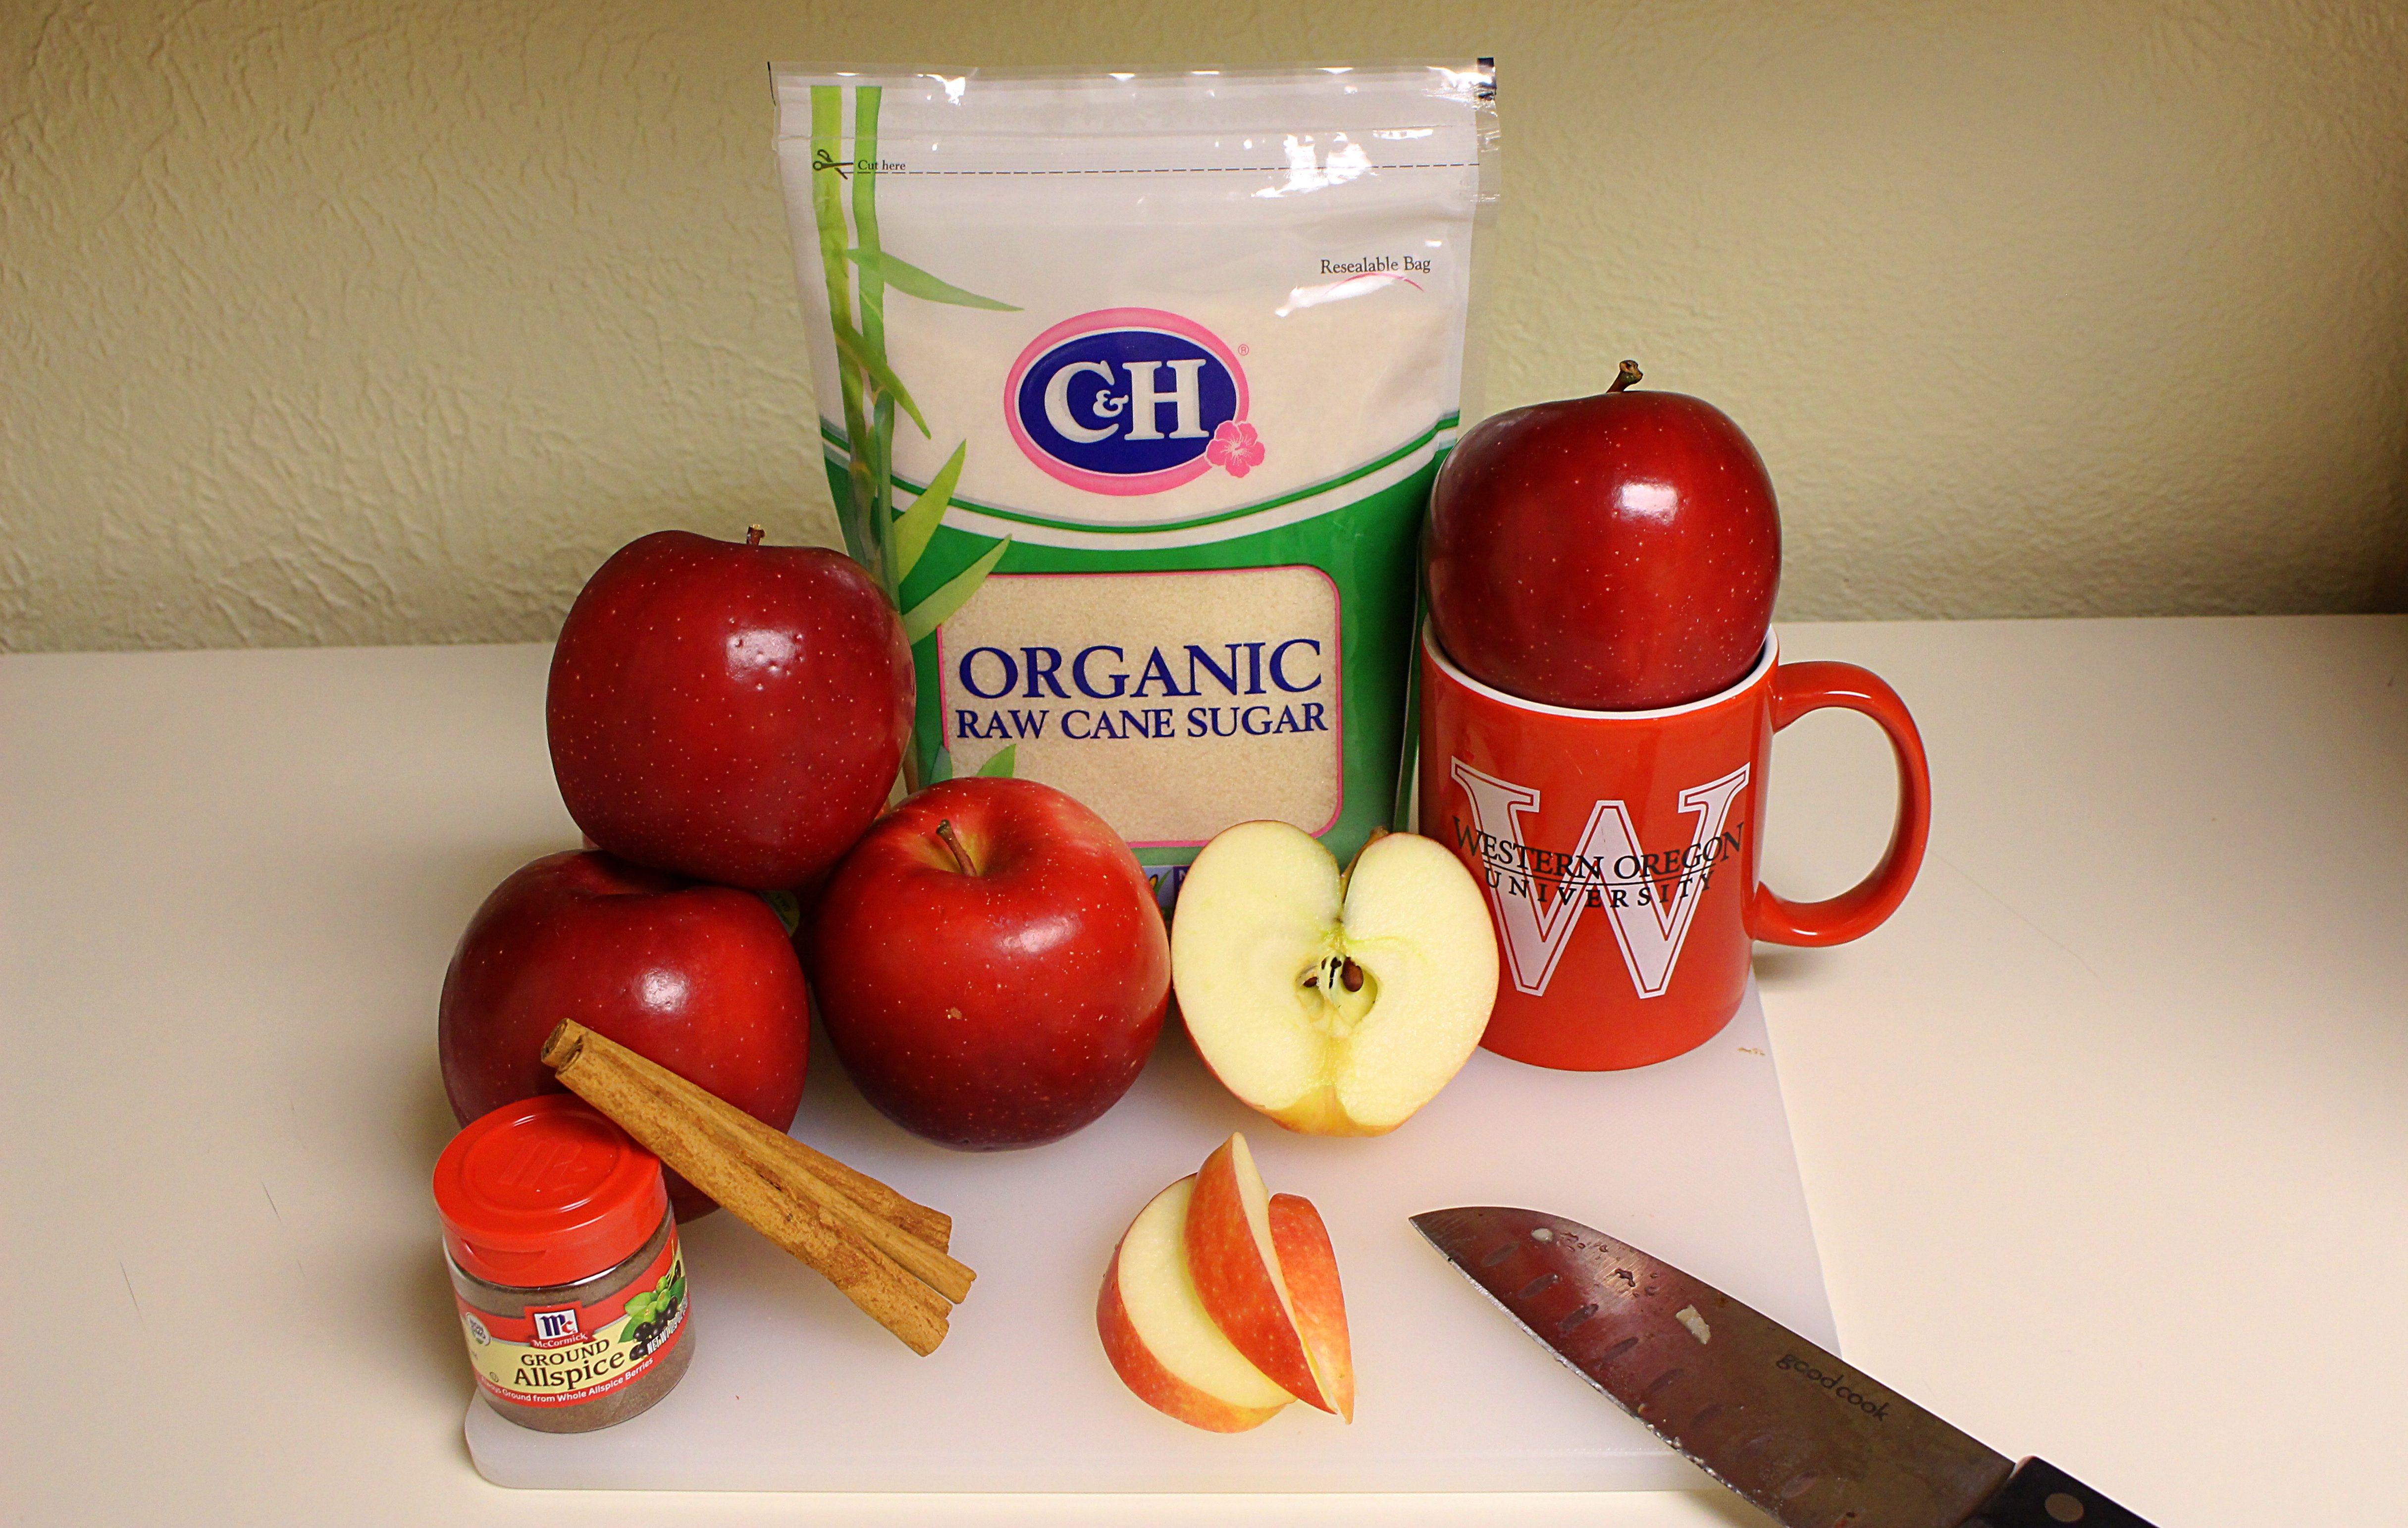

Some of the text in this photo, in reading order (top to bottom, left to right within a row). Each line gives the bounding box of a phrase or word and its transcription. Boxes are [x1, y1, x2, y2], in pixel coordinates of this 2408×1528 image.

[858, 159, 906, 170] Cut here
[1320, 255, 1431, 274] Resealable Bag
[1044, 358, 1209, 444] C&H
[958, 638, 1323, 699] ORGANIC
[955, 702, 1329, 739] RAW CANE SUGAR
[1452, 815, 1744, 880] WESTERN OREGON
[1451, 755, 1751, 1000] W
[1485, 866, 1715, 908] UNIVERSITY
[521, 1338, 610, 1366] GROUND
[532, 1332, 588, 1348] McCormick
[646, 1335, 660, 1355] NET
[502, 1388, 531, 1401] Ground
[556, 1391, 587, 1402] Whole
[588, 1377, 624, 1396] Allspice
[625, 1357, 654, 1380] Berries
[513, 1351, 625, 1390] Allspice
[1835, 1386, 1889, 1422] cook
